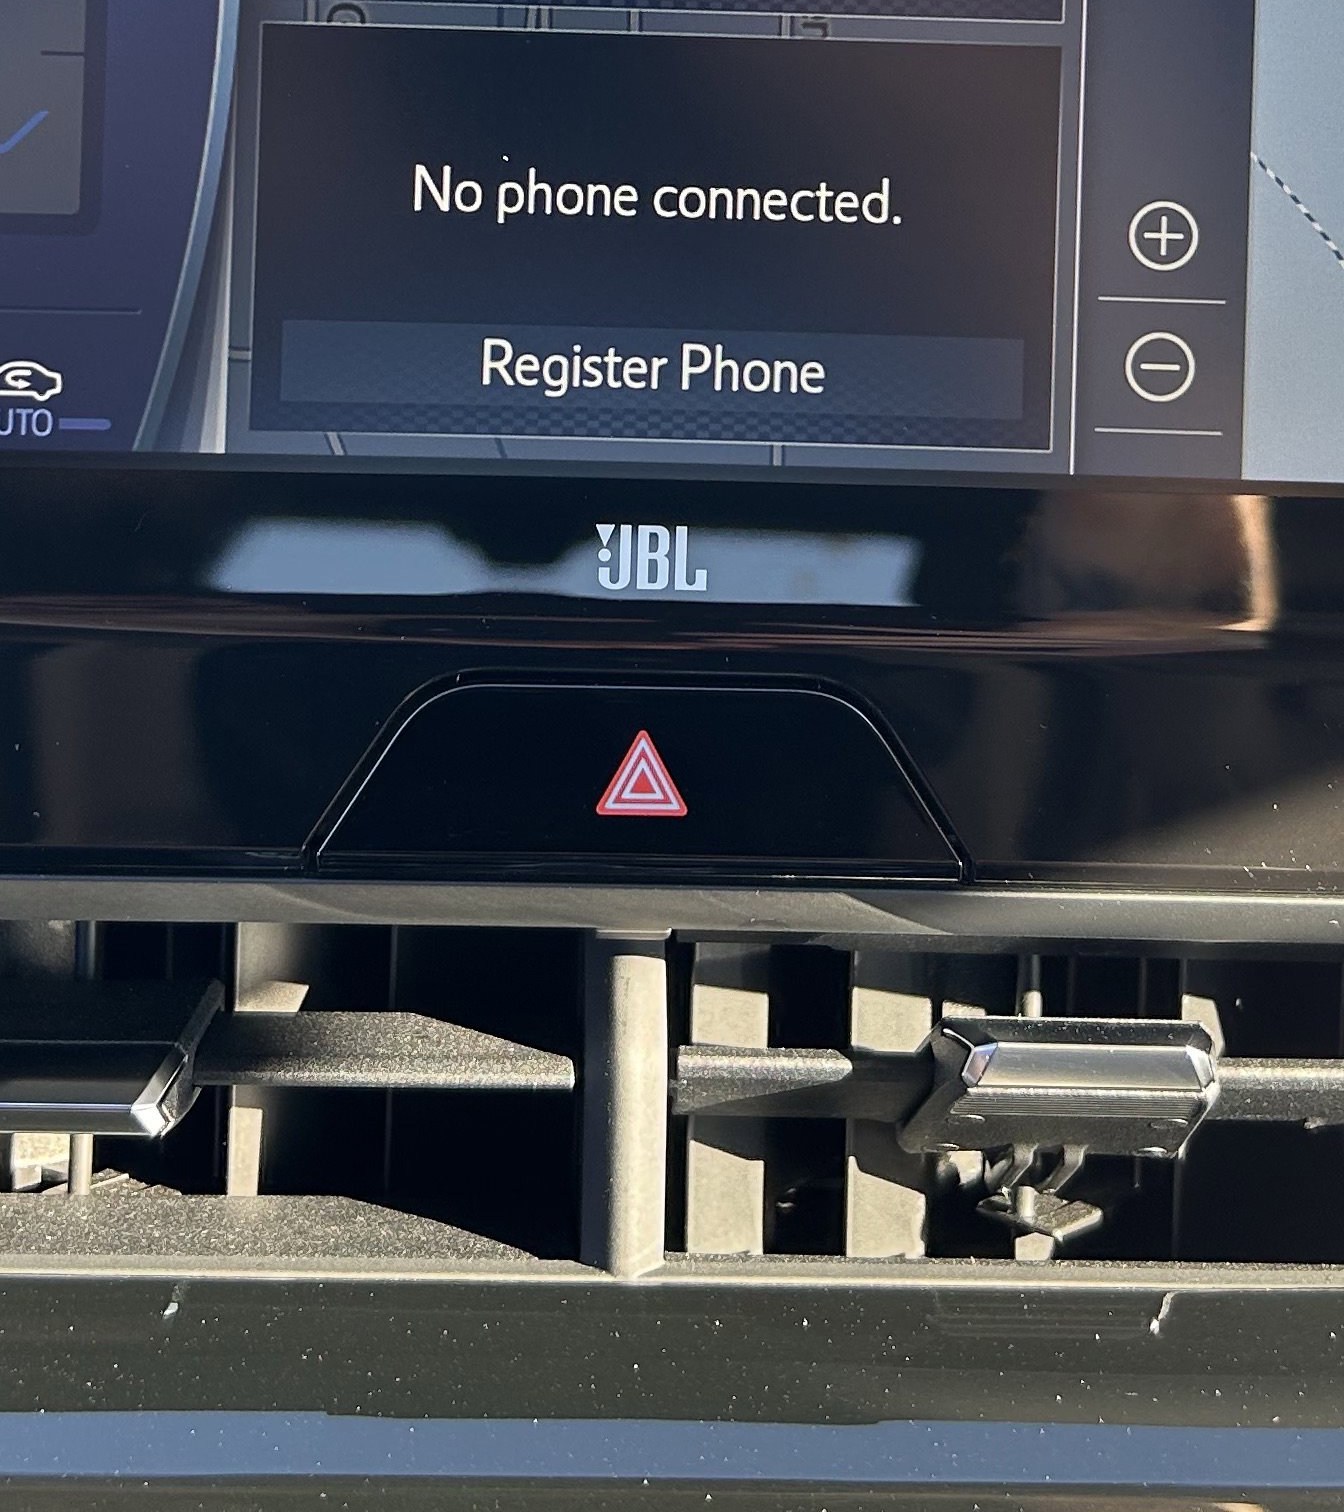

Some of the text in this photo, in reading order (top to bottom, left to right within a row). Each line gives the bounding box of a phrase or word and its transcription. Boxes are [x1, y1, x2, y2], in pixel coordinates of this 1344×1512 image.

[413, 163, 903, 226] No phone connected.
[481, 337, 826, 399] Register Phone
[595, 523, 709, 593] JBL
